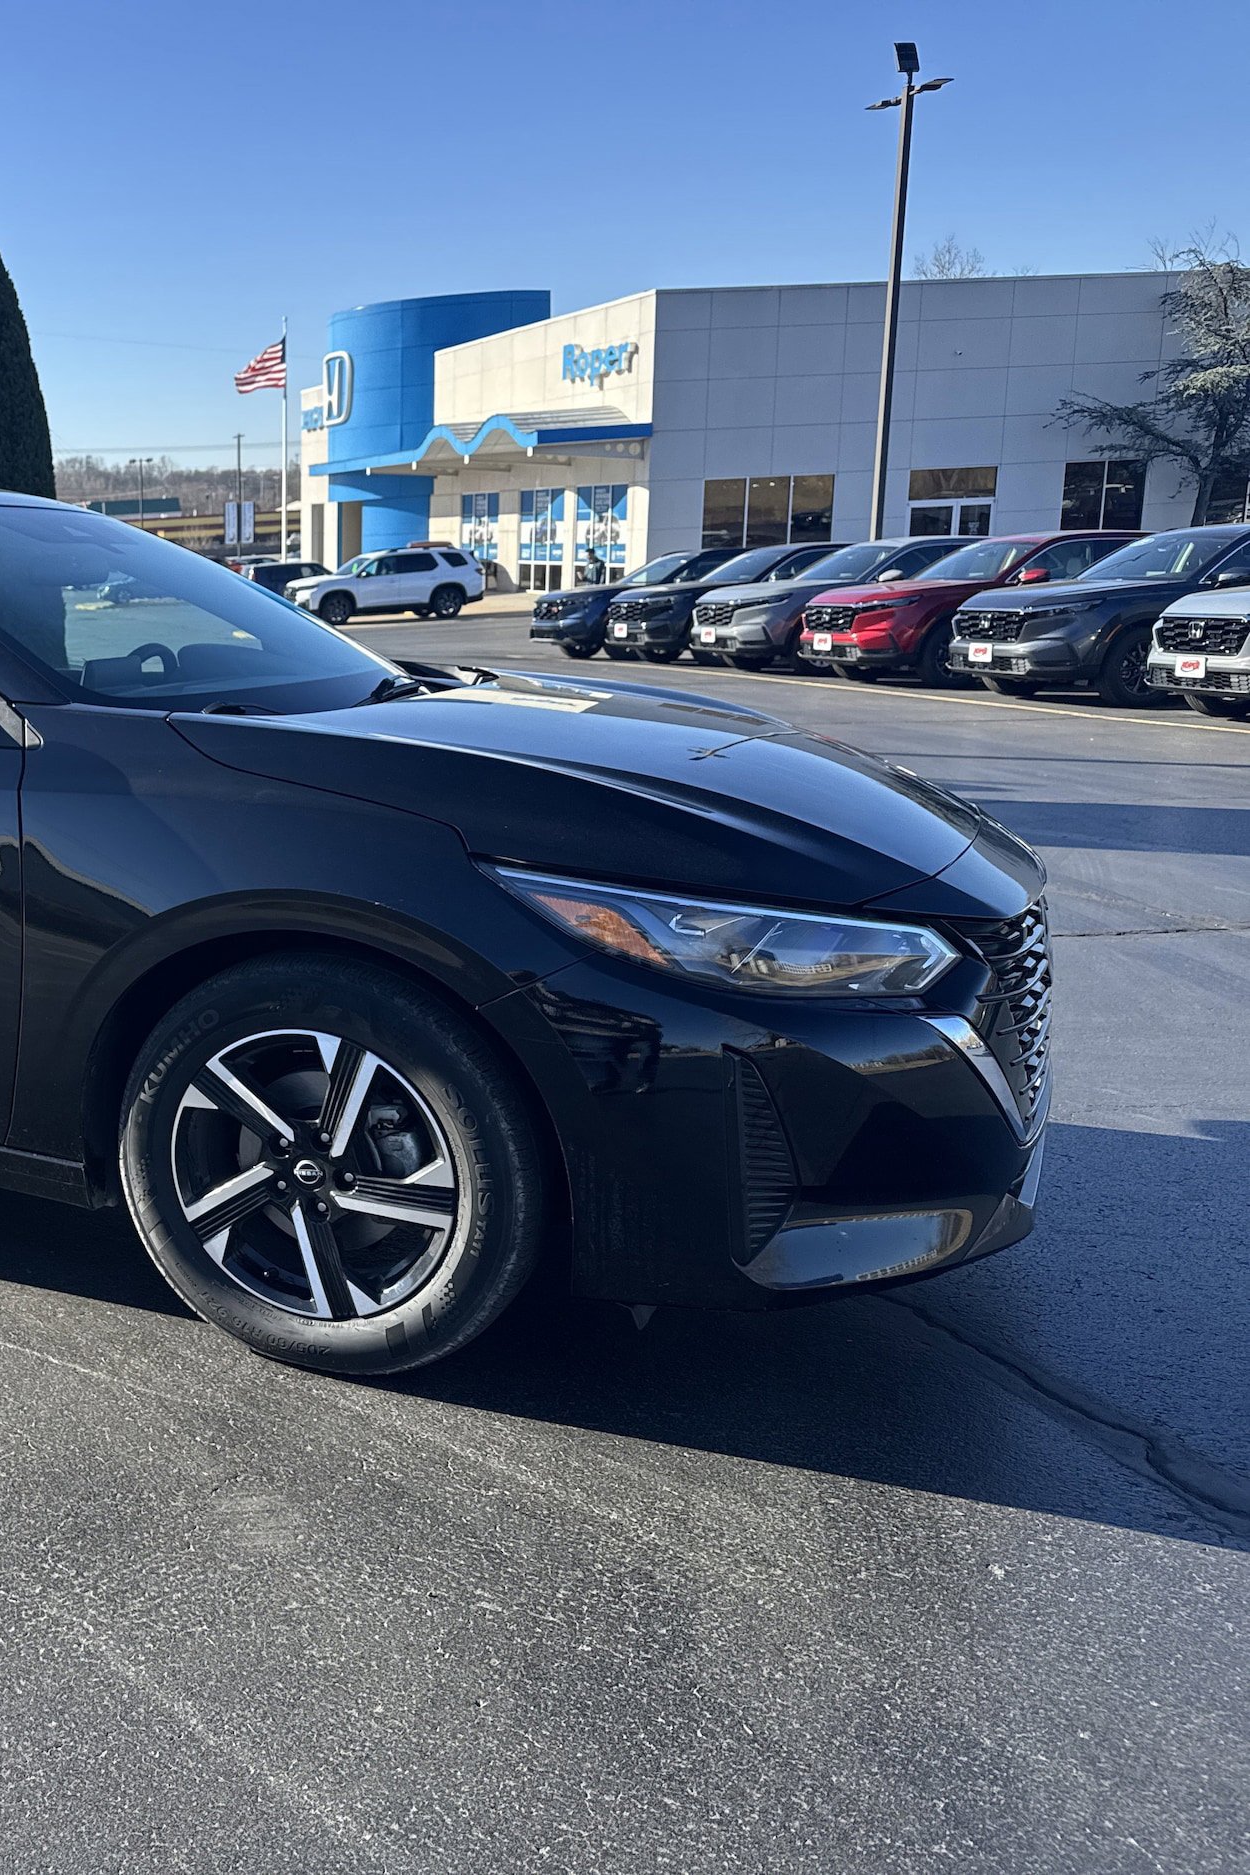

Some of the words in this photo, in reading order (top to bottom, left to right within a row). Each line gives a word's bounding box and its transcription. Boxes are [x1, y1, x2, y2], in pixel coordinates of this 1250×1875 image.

[562, 341, 630, 387] Roper
[140, 1009, 220, 1105] KUMHO
[442, 1083, 495, 1216] SOLUS
